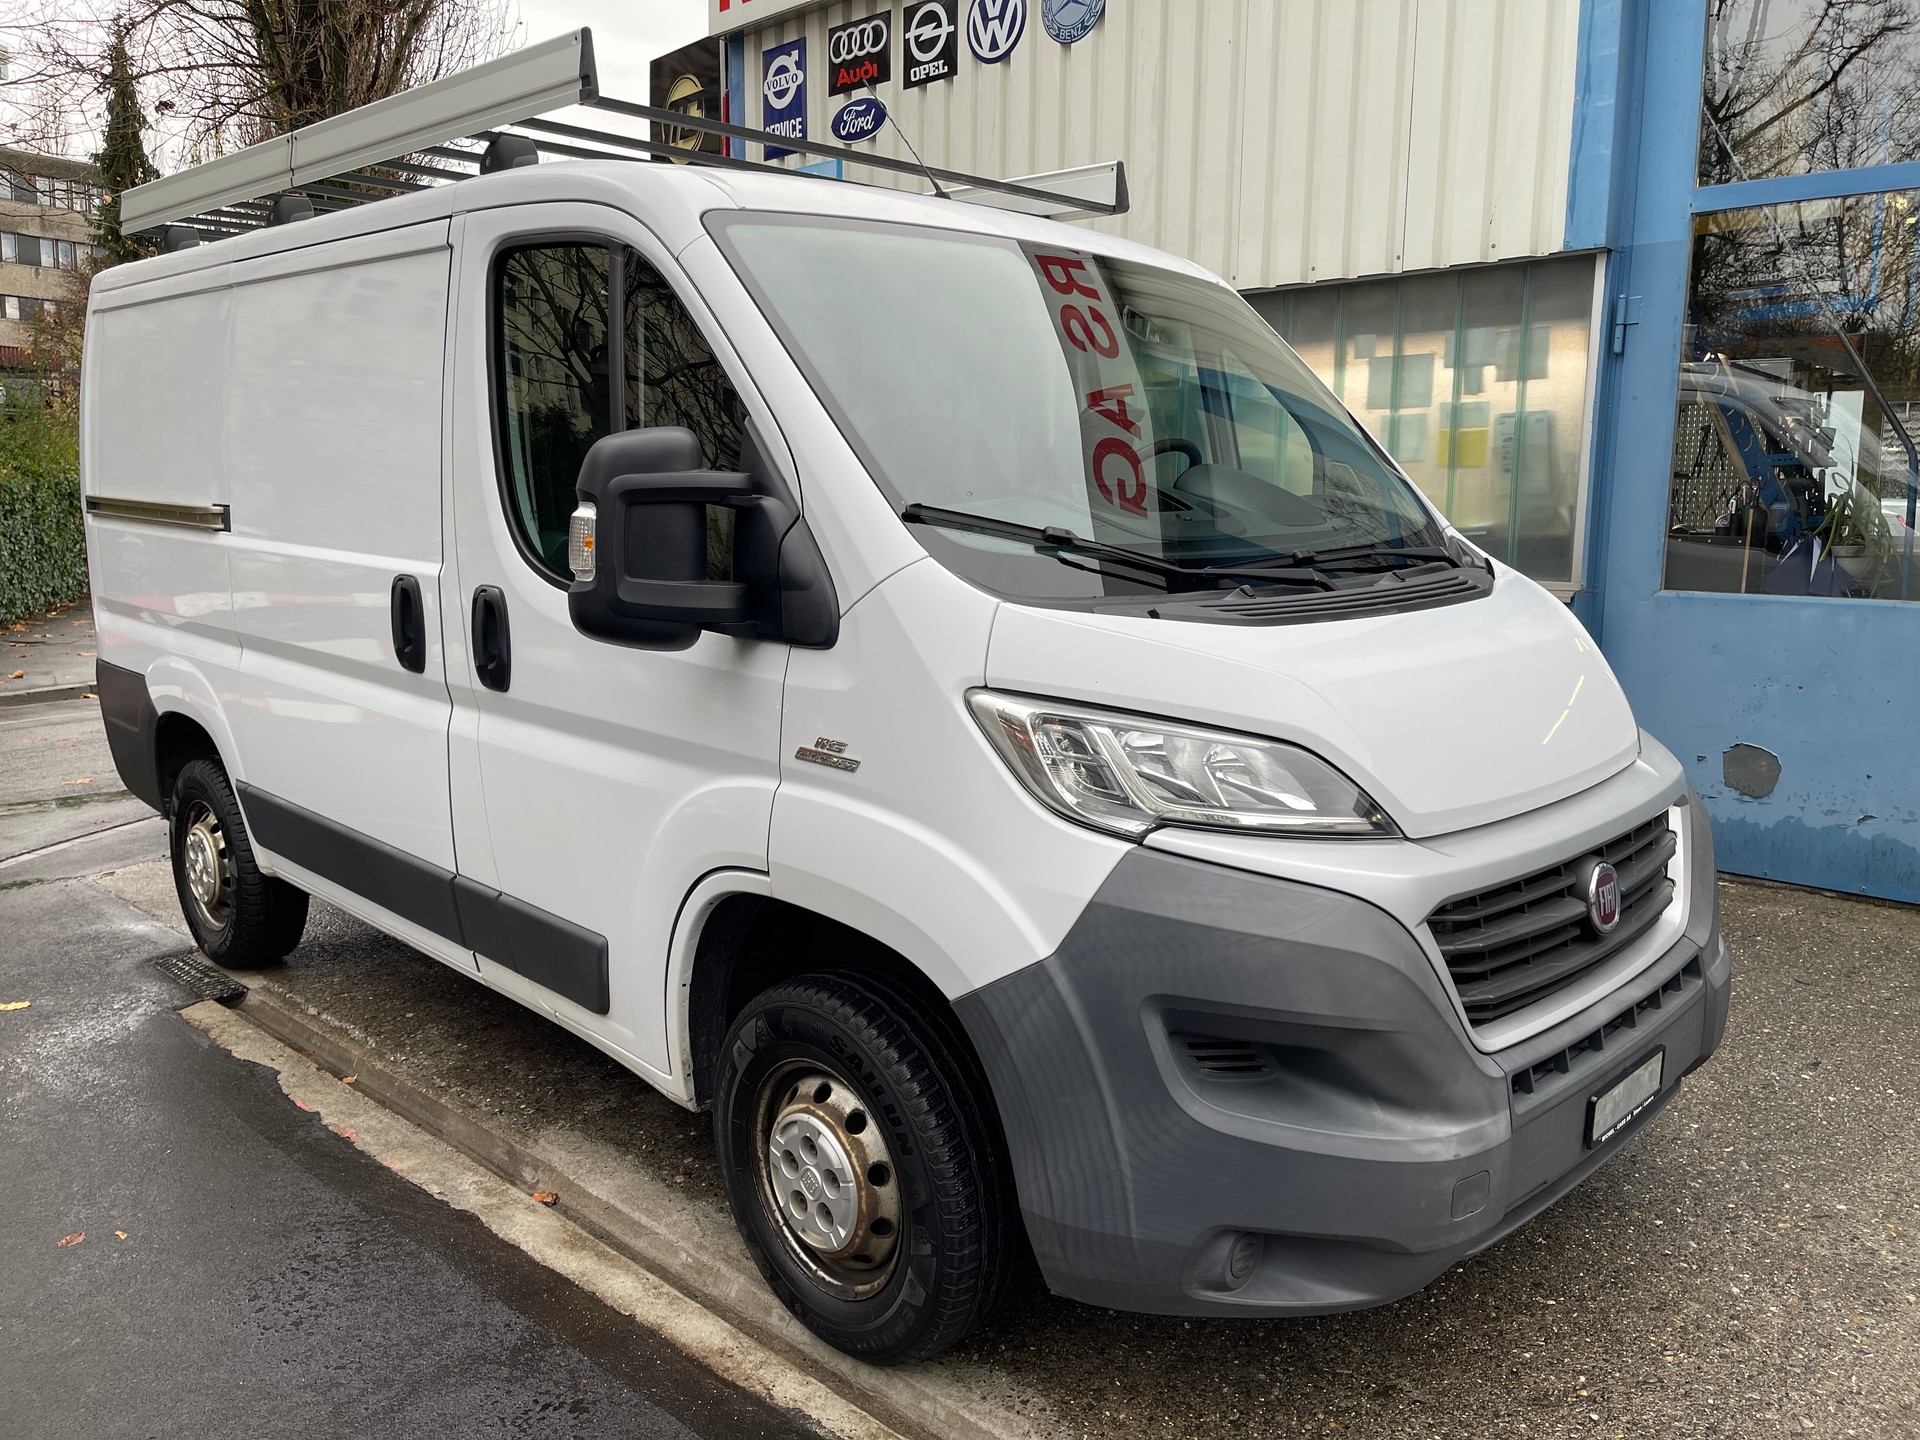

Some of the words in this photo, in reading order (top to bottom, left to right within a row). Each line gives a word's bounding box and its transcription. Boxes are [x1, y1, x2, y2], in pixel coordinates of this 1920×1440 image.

[1058, 25, 1084, 40] BENZ
[766, 72, 799, 92] VOLVO
[836, 59, 878, 88] Audi
[910, 59, 949, 82] OPEL
[765, 117, 803, 139] RVICE
[839, 103, 875, 136] Ford
[1597, 880, 1617, 917] FIAT
[828, 1034, 915, 1157] SAILUN
